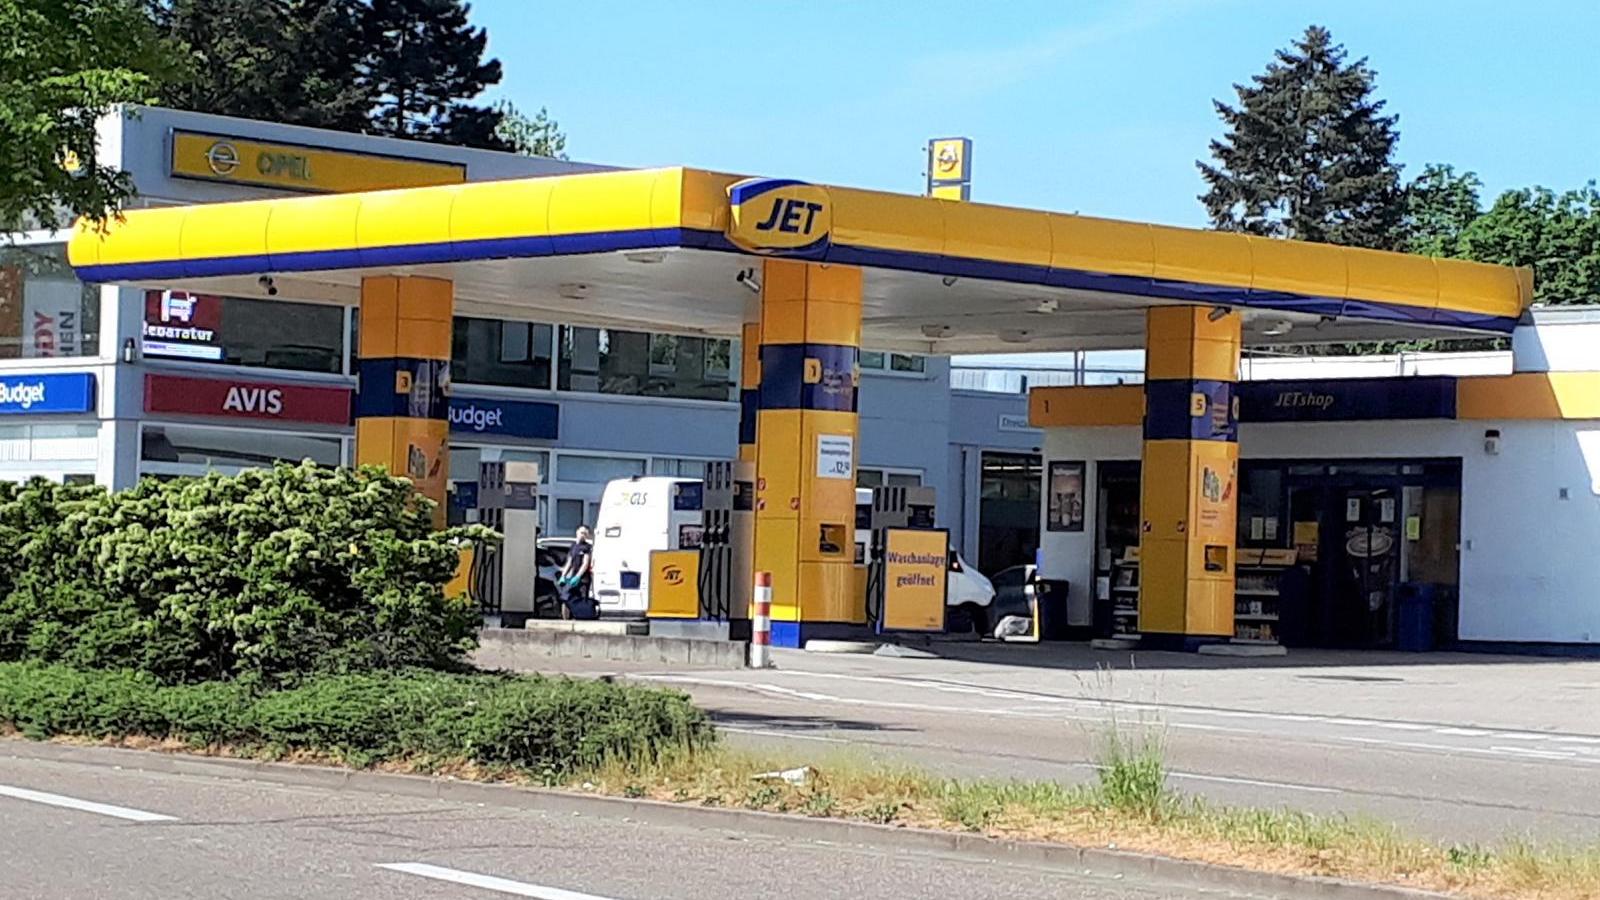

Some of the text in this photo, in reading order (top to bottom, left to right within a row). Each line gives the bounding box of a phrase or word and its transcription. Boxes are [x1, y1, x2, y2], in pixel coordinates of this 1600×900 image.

[257, 151, 312, 180] OPEL
[756, 198, 823, 235] JET
[222, 386, 282, 414] AVIS
[1274, 392, 1335, 410] JETshop
[448, 405, 503, 431] udget
[896, 573, 935, 588] geöffnet
